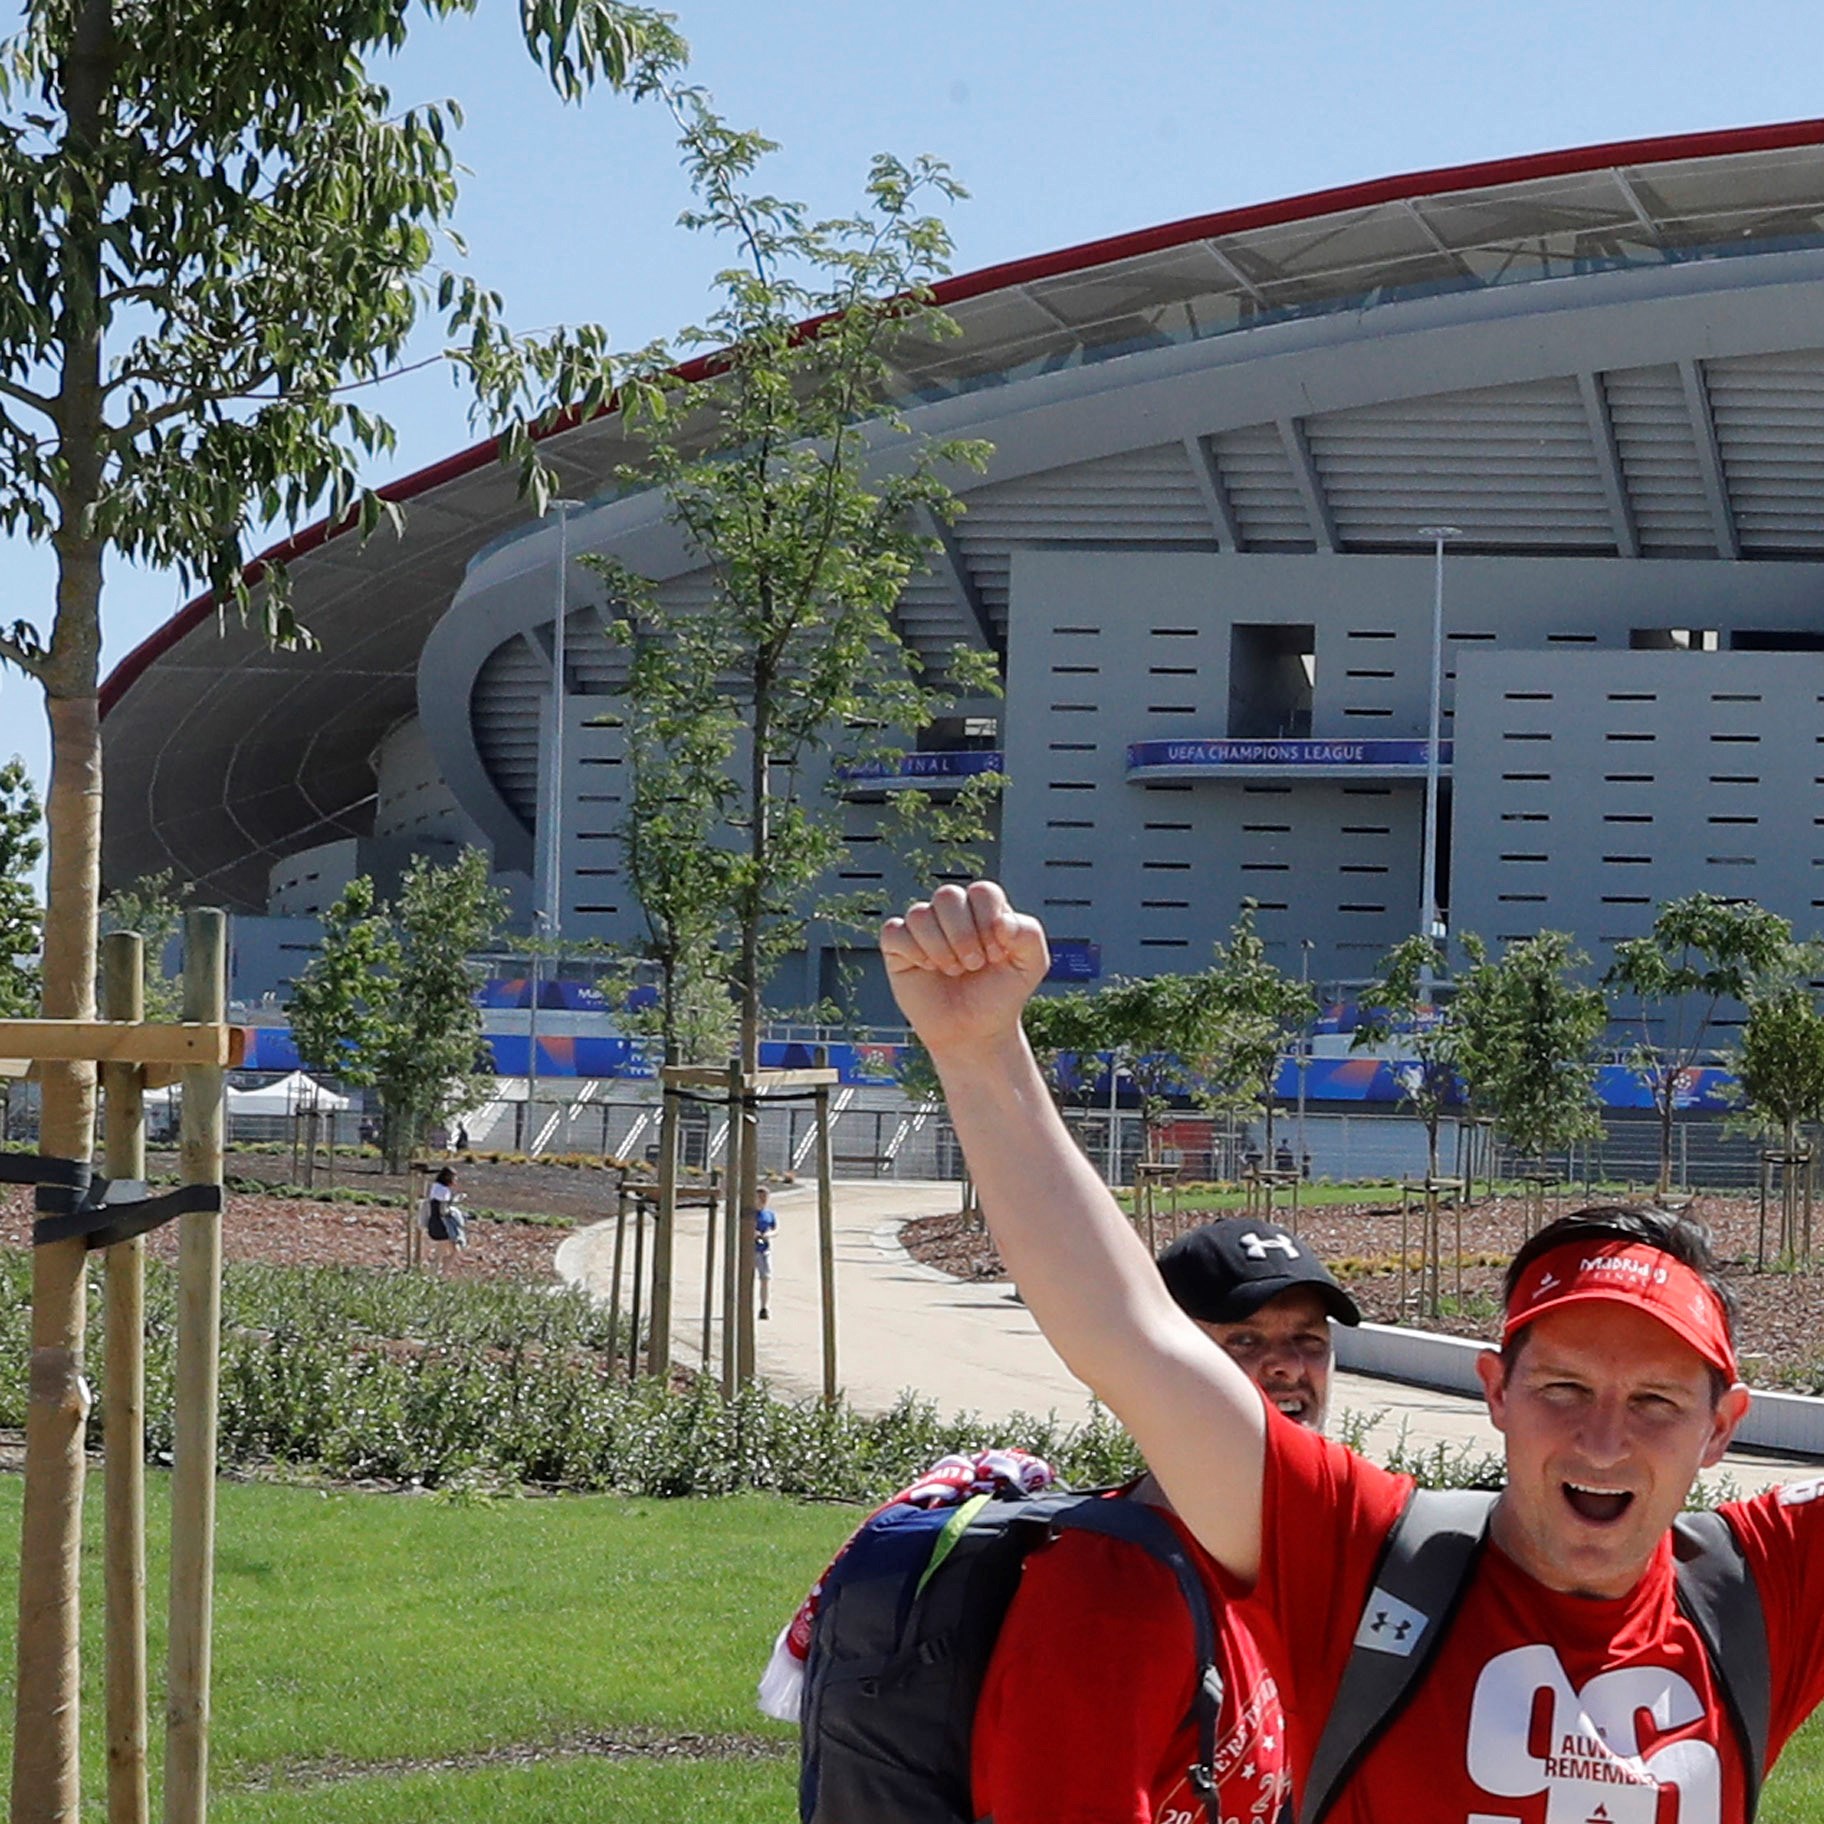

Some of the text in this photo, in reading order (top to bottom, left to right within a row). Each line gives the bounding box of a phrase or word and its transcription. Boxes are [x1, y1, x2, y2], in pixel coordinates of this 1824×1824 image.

[1168, 745, 1364, 761] UEFA CHAMPIONS LEAGUE
[900, 757, 950, 772] INAL
